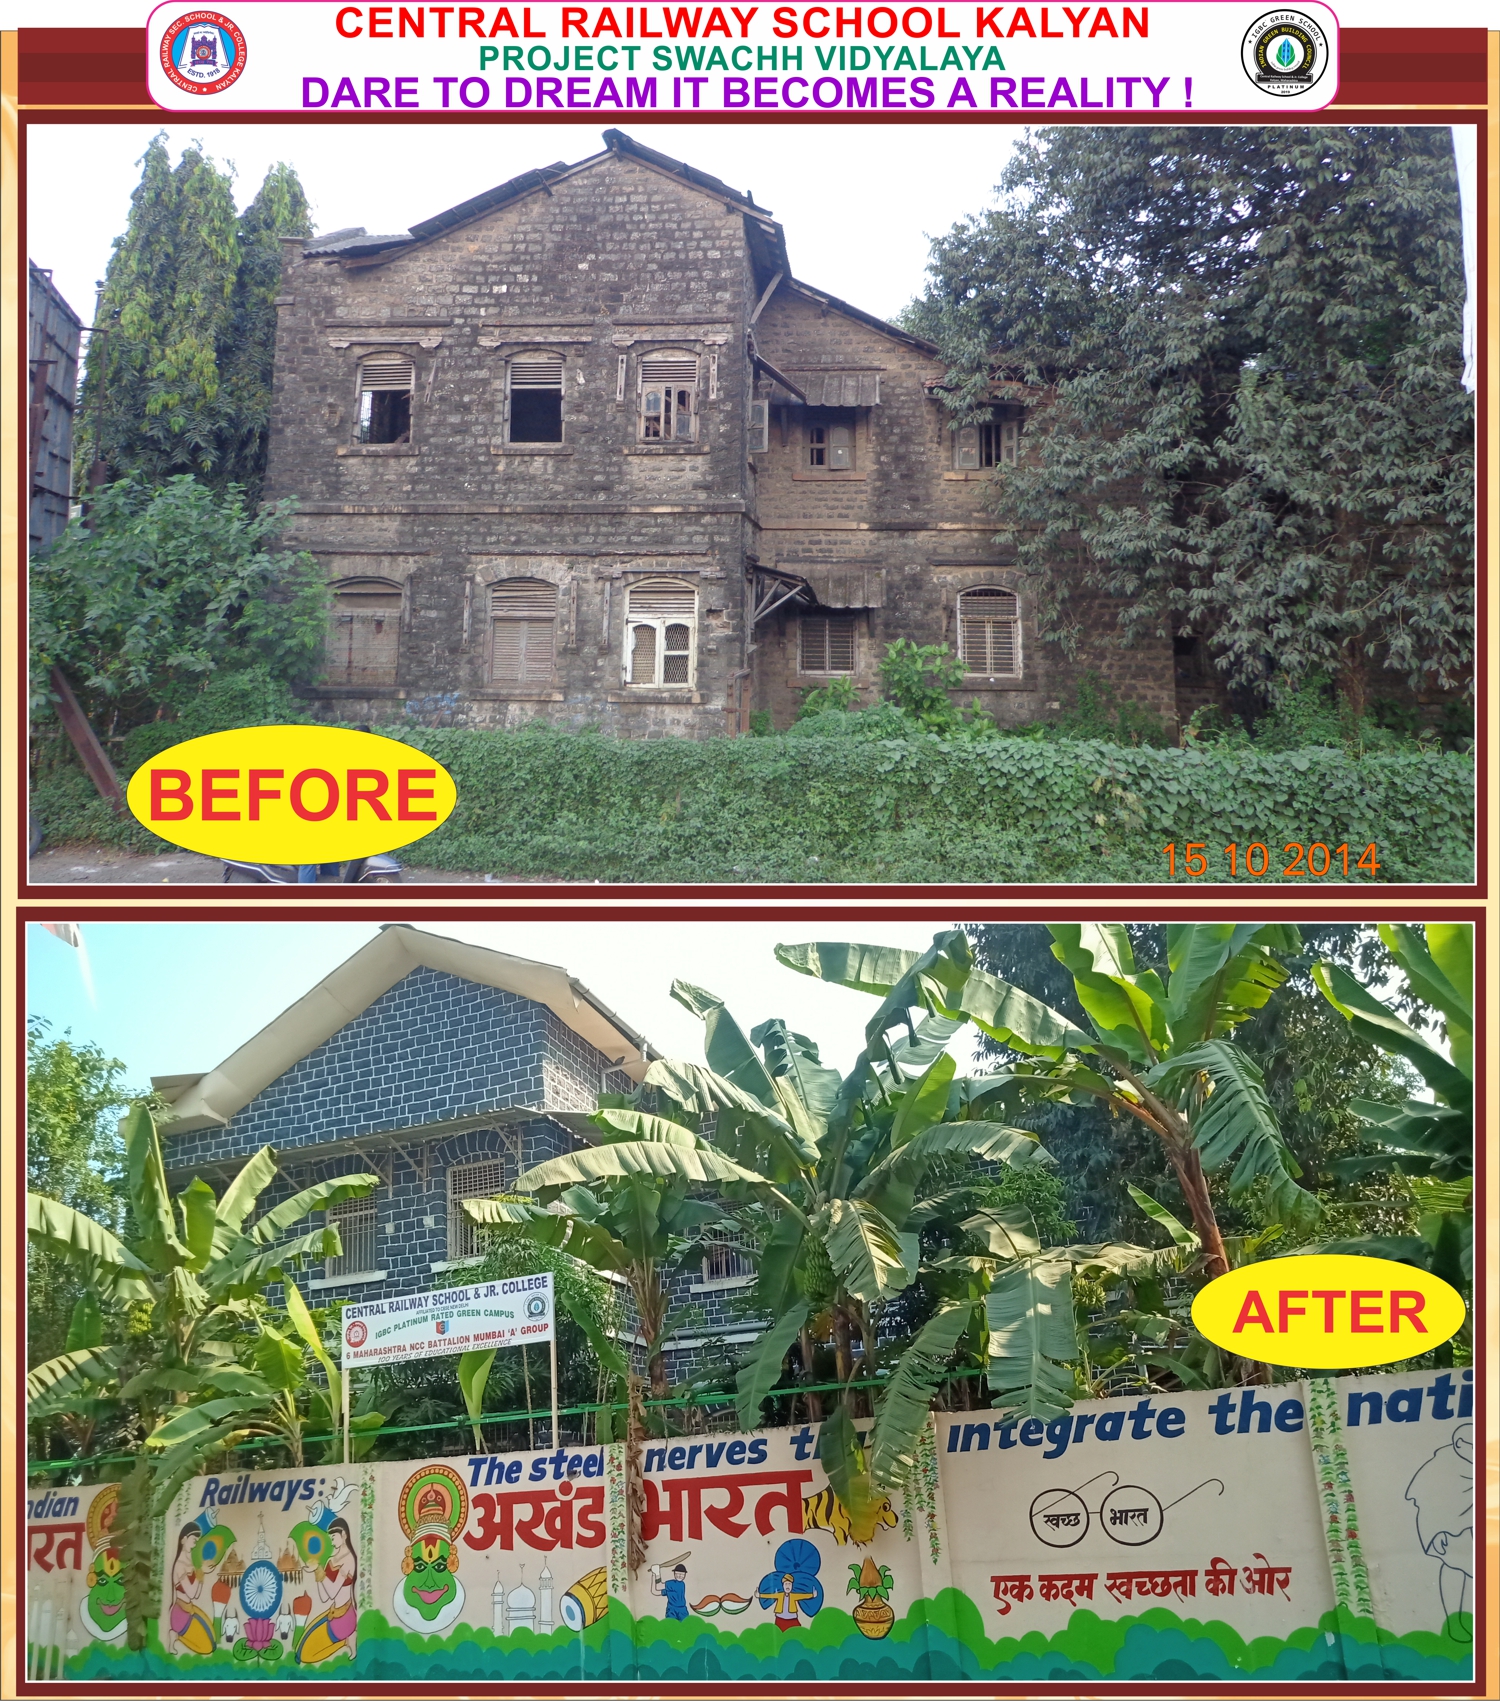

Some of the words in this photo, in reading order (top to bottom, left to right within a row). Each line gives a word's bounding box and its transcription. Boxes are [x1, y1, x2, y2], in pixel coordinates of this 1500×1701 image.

[346, 1303, 386, 1320] CENTRAL
[388, 1296, 429, 1314] RAILWAY
[432, 1289, 471, 1307] SCHOOL
[473, 1287, 481, 1299] &
[484, 1284, 499, 1298] JR.
[501, 1275, 548, 1295] COLLEGE
[346, 1352, 351, 1360] 6
[353, 1344, 407, 1359] MAHARASHTRA
[409, 1341, 425, 1351] NCC
[427, 1334, 471, 1349] BATTALION
[473, 1329, 505, 1342] MUMBAI
[520, 1322, 549, 1336] GROUP
[375, 1326, 392, 1340] IGBC
[393, 1315, 428, 1332] PLATINUM
[430, 1310, 454, 1322] RATED
[456, 1308, 481, 1318] GREEN
[483, 1308, 515, 1319] CAMPUS
[378, 1355, 391, 1364] 100
[392, 1352, 413, 1362] YEARS
[414, 1350, 424, 1359] OF
[424, 1344, 470, 1357] EDUCATIONAL
[471, 1338, 513, 1350] EXCELLENCE
[1208, 1390, 1304, 1436] the
[467, 1456, 523, 1487] The
[528, 1446, 605, 1483] steel
[643, 1437, 767, 1473] nerves
[199, 1474, 326, 1512] Railways:
[462, 1480, 606, 1552] अखंड
[641, 1470, 814, 1542] भारत
[1043, 1512, 1081, 1531] स्वच्छ
[1109, 1507, 1150, 1527] भारत
[990, 1574, 1034, 1616] एक
[1038, 1572, 1099, 1606] कदम
[1104, 1569, 1199, 1604] स्वच्छता
[1205, 1557, 1238, 1597] की
[1240, 1552, 1293, 1602] ओर
